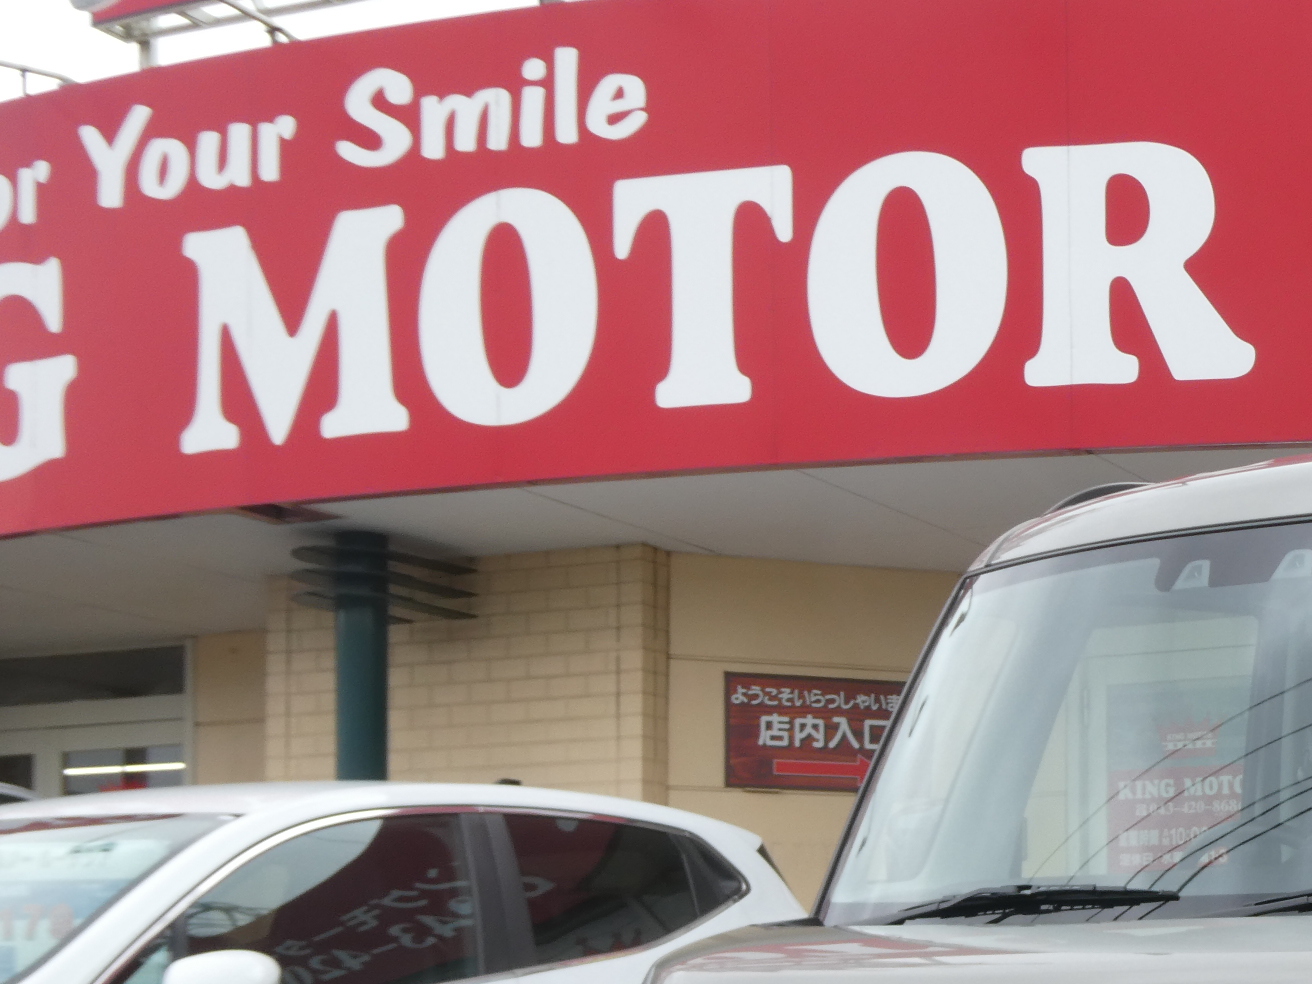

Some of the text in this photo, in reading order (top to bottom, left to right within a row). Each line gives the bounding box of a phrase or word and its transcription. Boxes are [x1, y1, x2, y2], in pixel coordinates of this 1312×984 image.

[77, 104, 297, 208] Your
[335, 46, 649, 168] Smile
[179, 141, 1256, 455] MOTOR
[758, 713, 891, 750] 店内入口
[1118, 778, 1176, 801] KING
